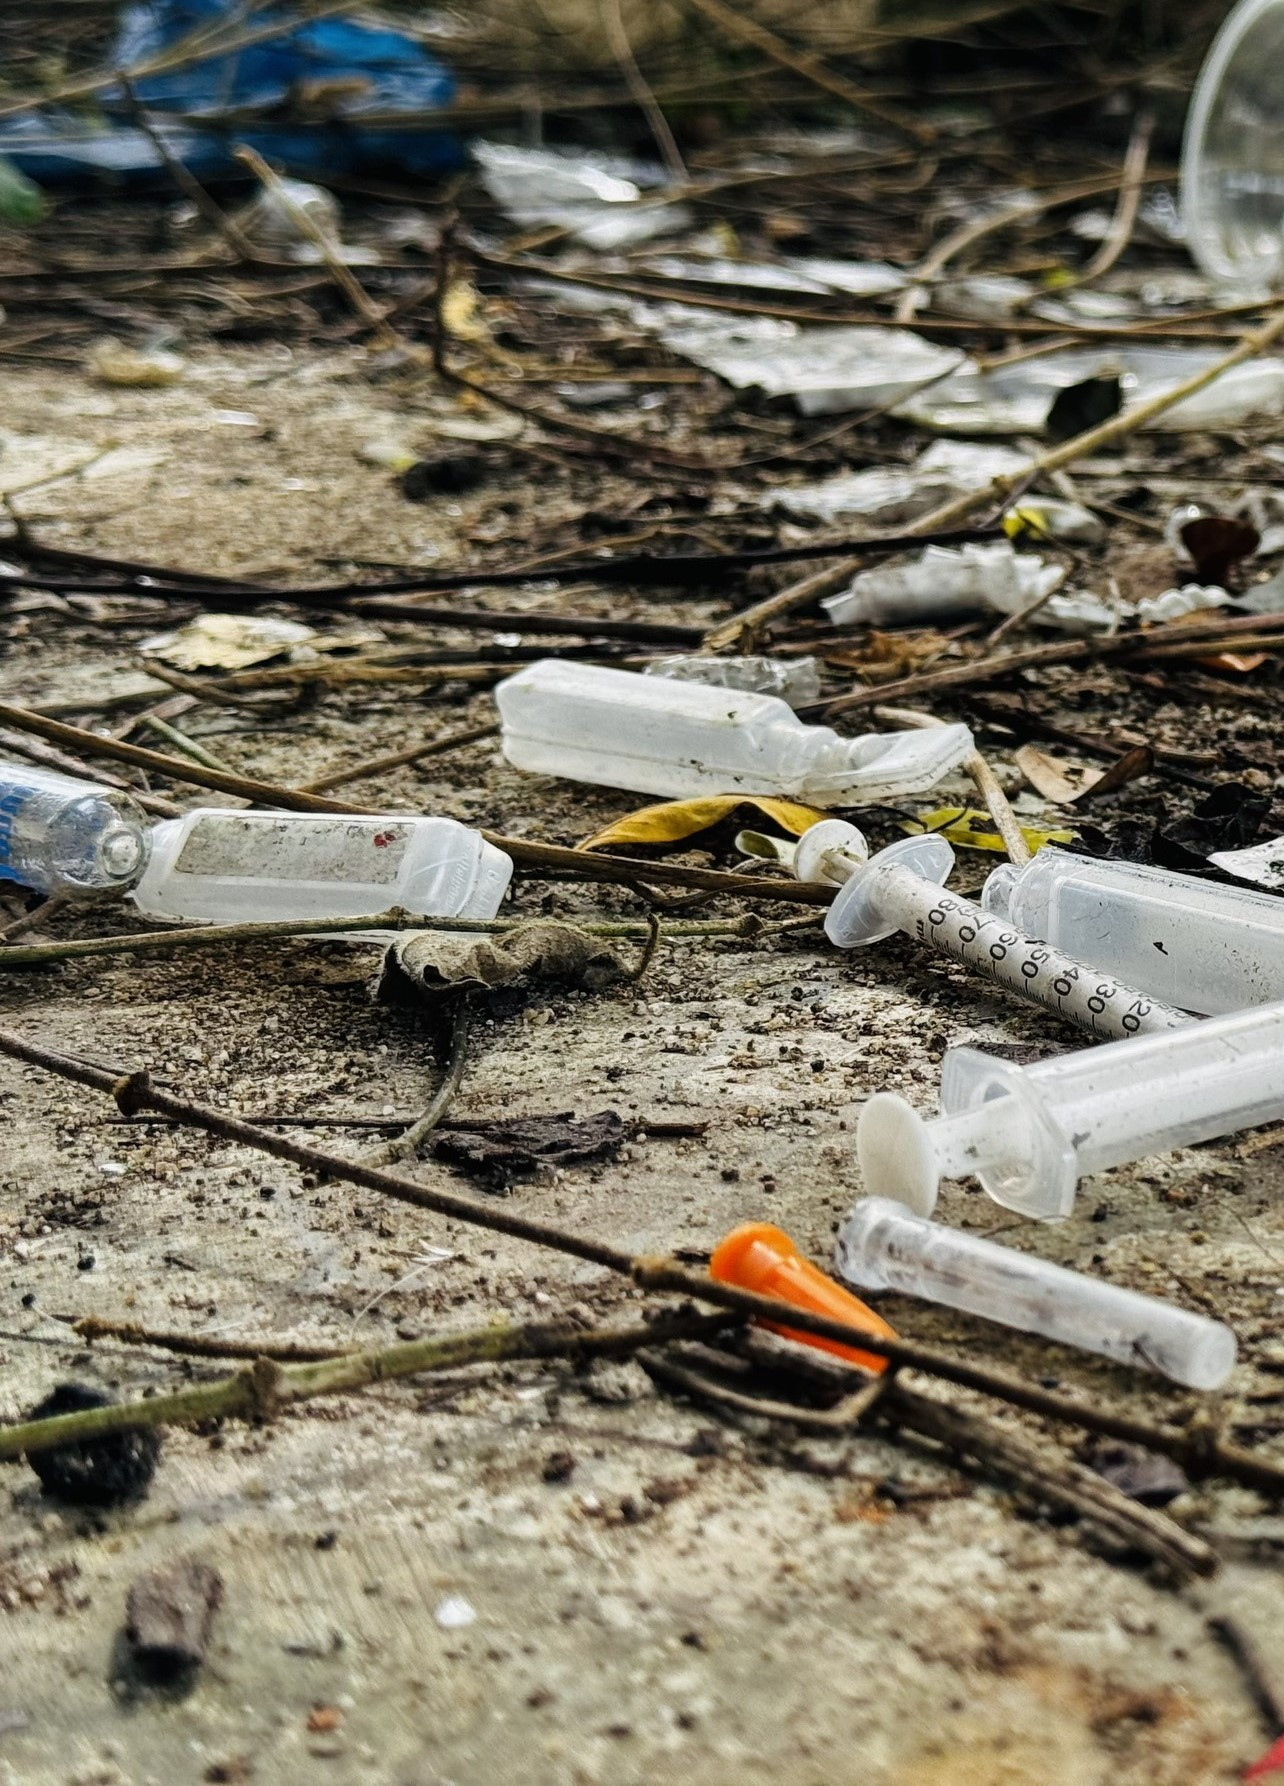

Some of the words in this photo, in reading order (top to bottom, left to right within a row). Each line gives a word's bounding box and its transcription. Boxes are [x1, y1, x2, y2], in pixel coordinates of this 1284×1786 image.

[928, 898, 959, 926] 80
[958, 915, 996, 944] 70
[988, 931, 1018, 961] 60
[1021, 947, 1051, 979] 50
[1053, 966, 1080, 997] 40
[1087, 983, 1117, 1015] 30
[1121, 999, 1153, 1033] 20
